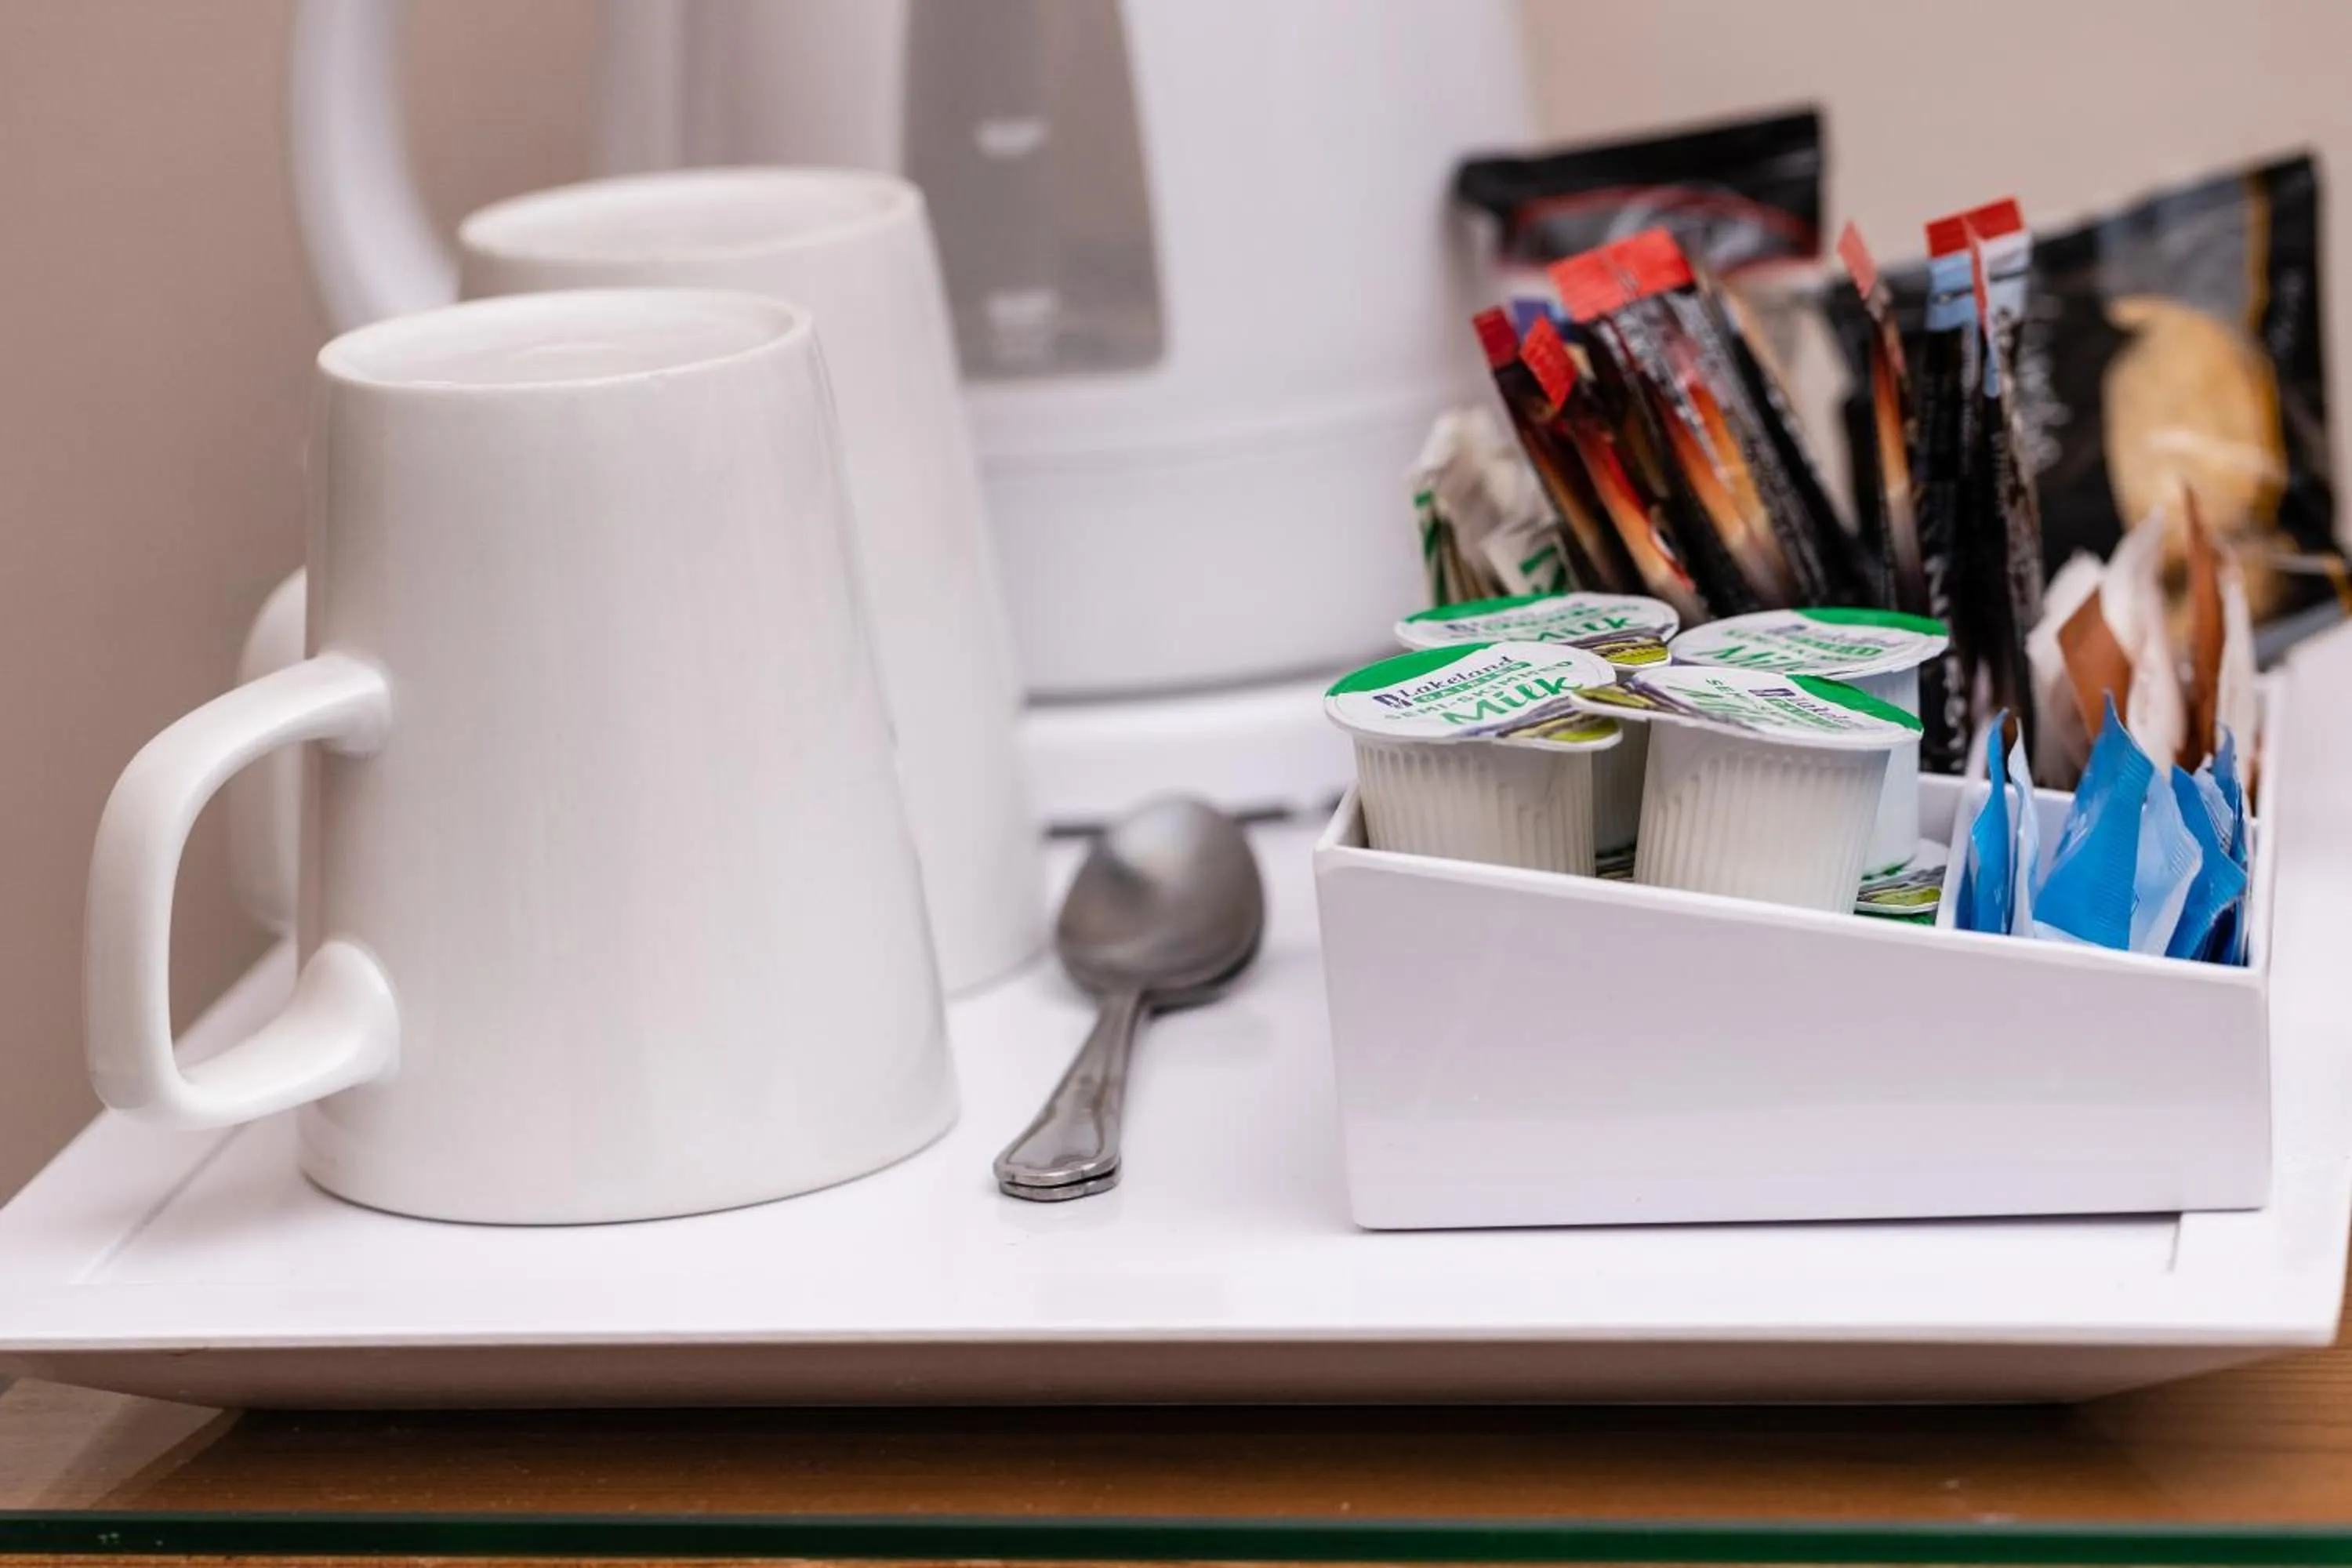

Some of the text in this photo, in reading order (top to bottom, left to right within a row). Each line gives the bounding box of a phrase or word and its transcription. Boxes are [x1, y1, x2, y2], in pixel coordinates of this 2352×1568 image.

[1385, 660, 1573, 720] SEMI-SKIMMED
[1399, 655, 1515, 697] Lakeland
[1441, 677, 1583, 725] Milk
